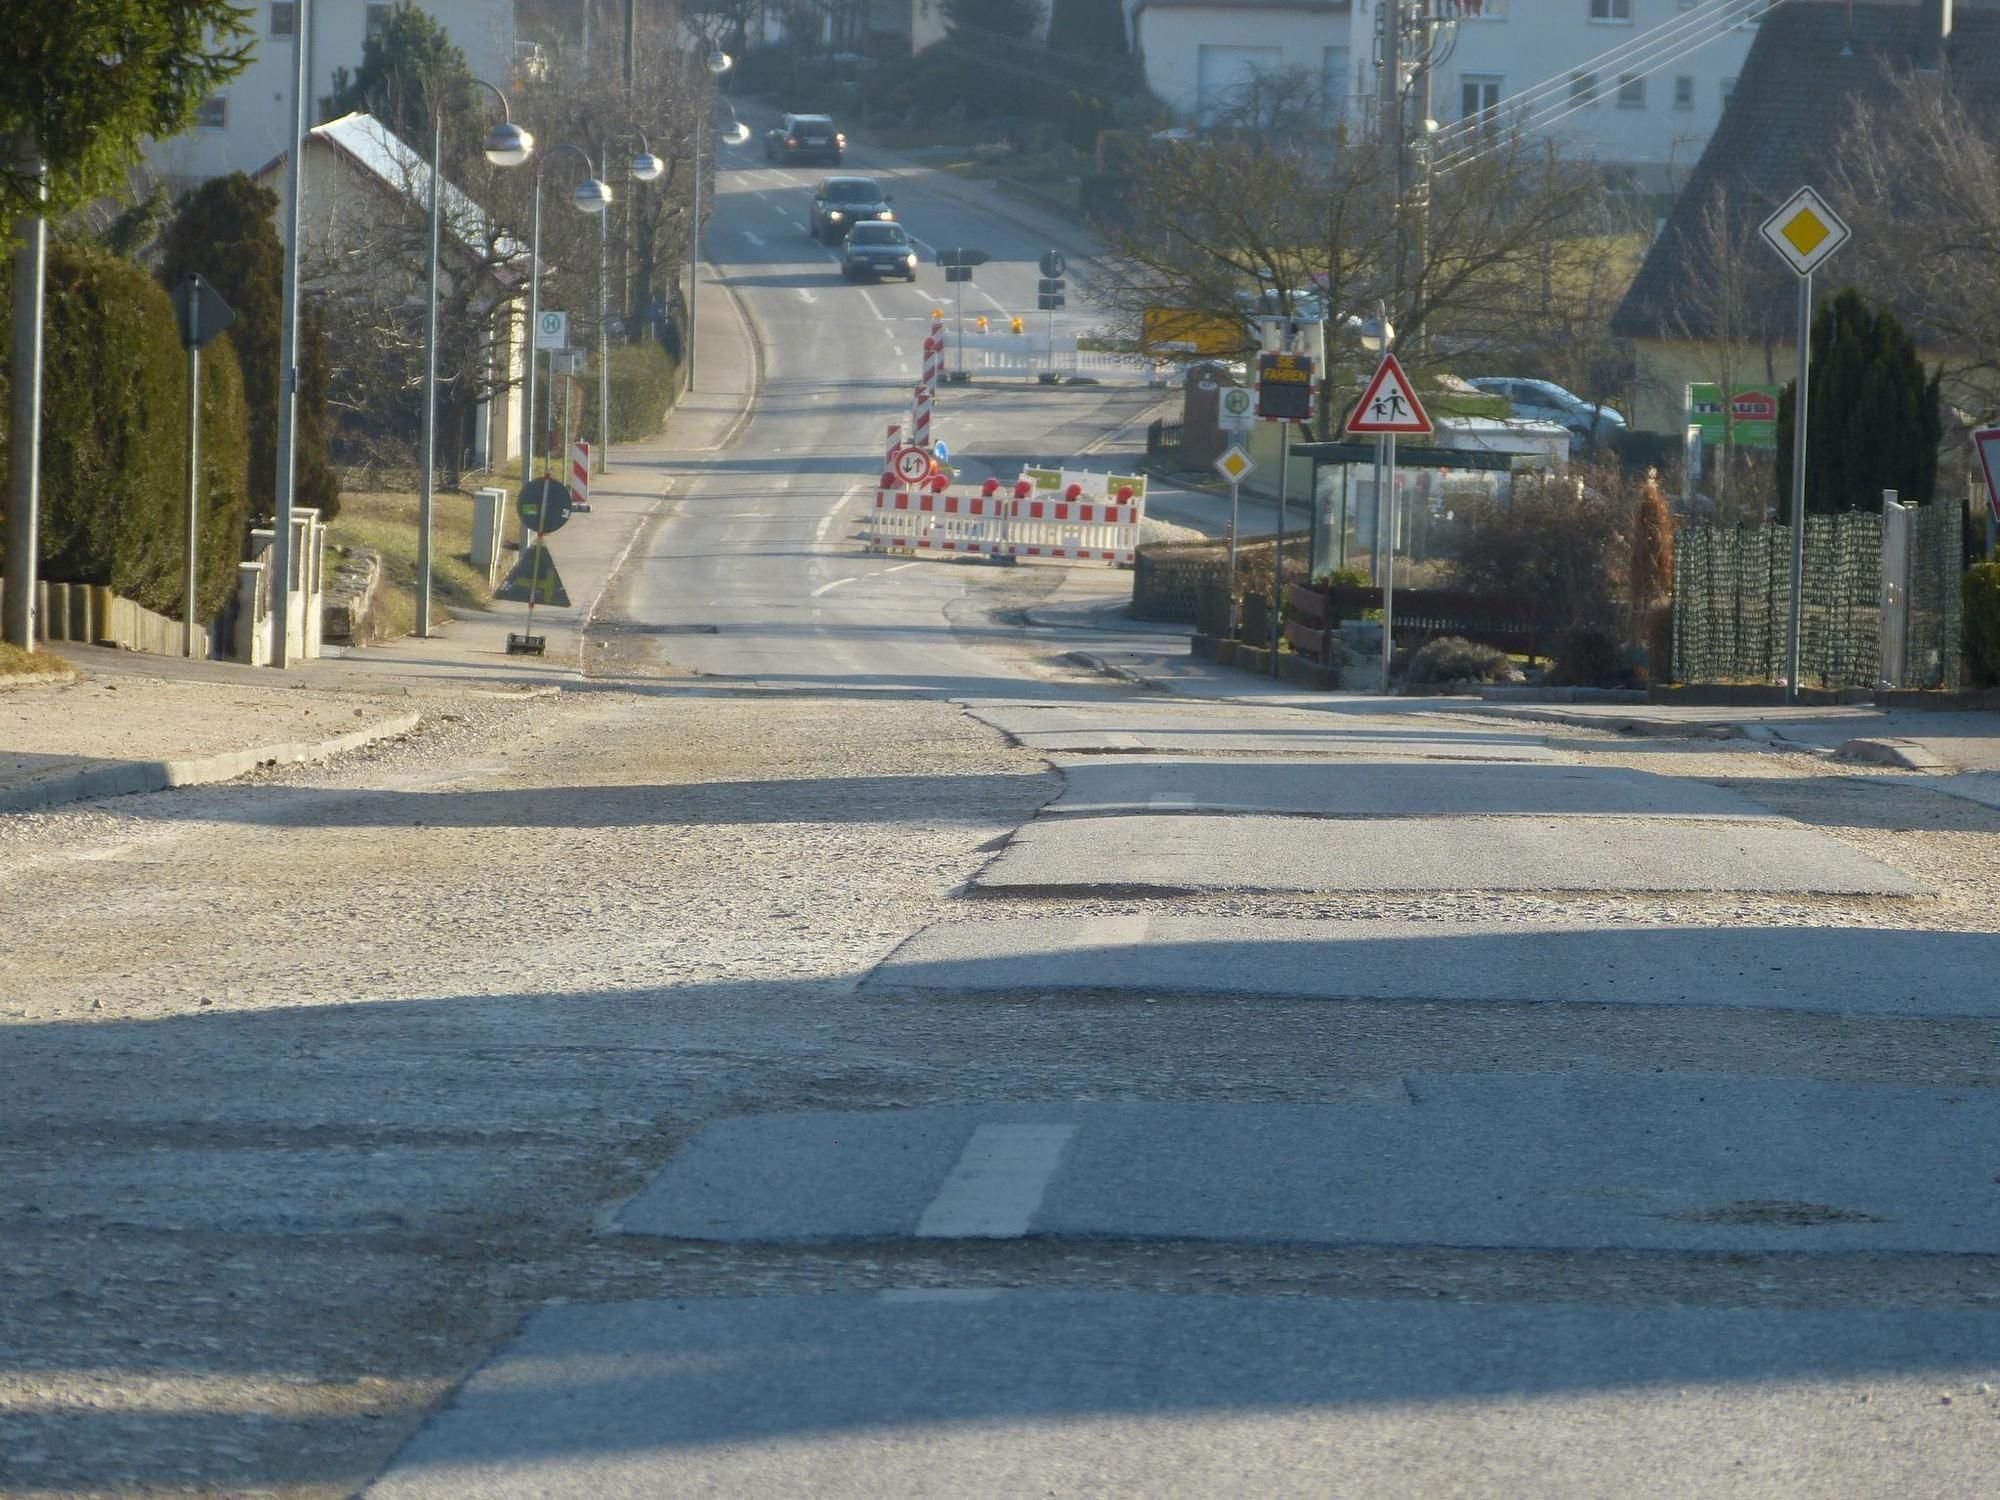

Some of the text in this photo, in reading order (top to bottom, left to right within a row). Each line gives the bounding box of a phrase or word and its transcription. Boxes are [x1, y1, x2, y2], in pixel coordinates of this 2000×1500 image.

[546, 319, 556, 329] H
[1277, 356, 1297, 368] SIE
[1263, 368, 1307, 382] FAHREN
[1231, 394, 1244, 408] H
